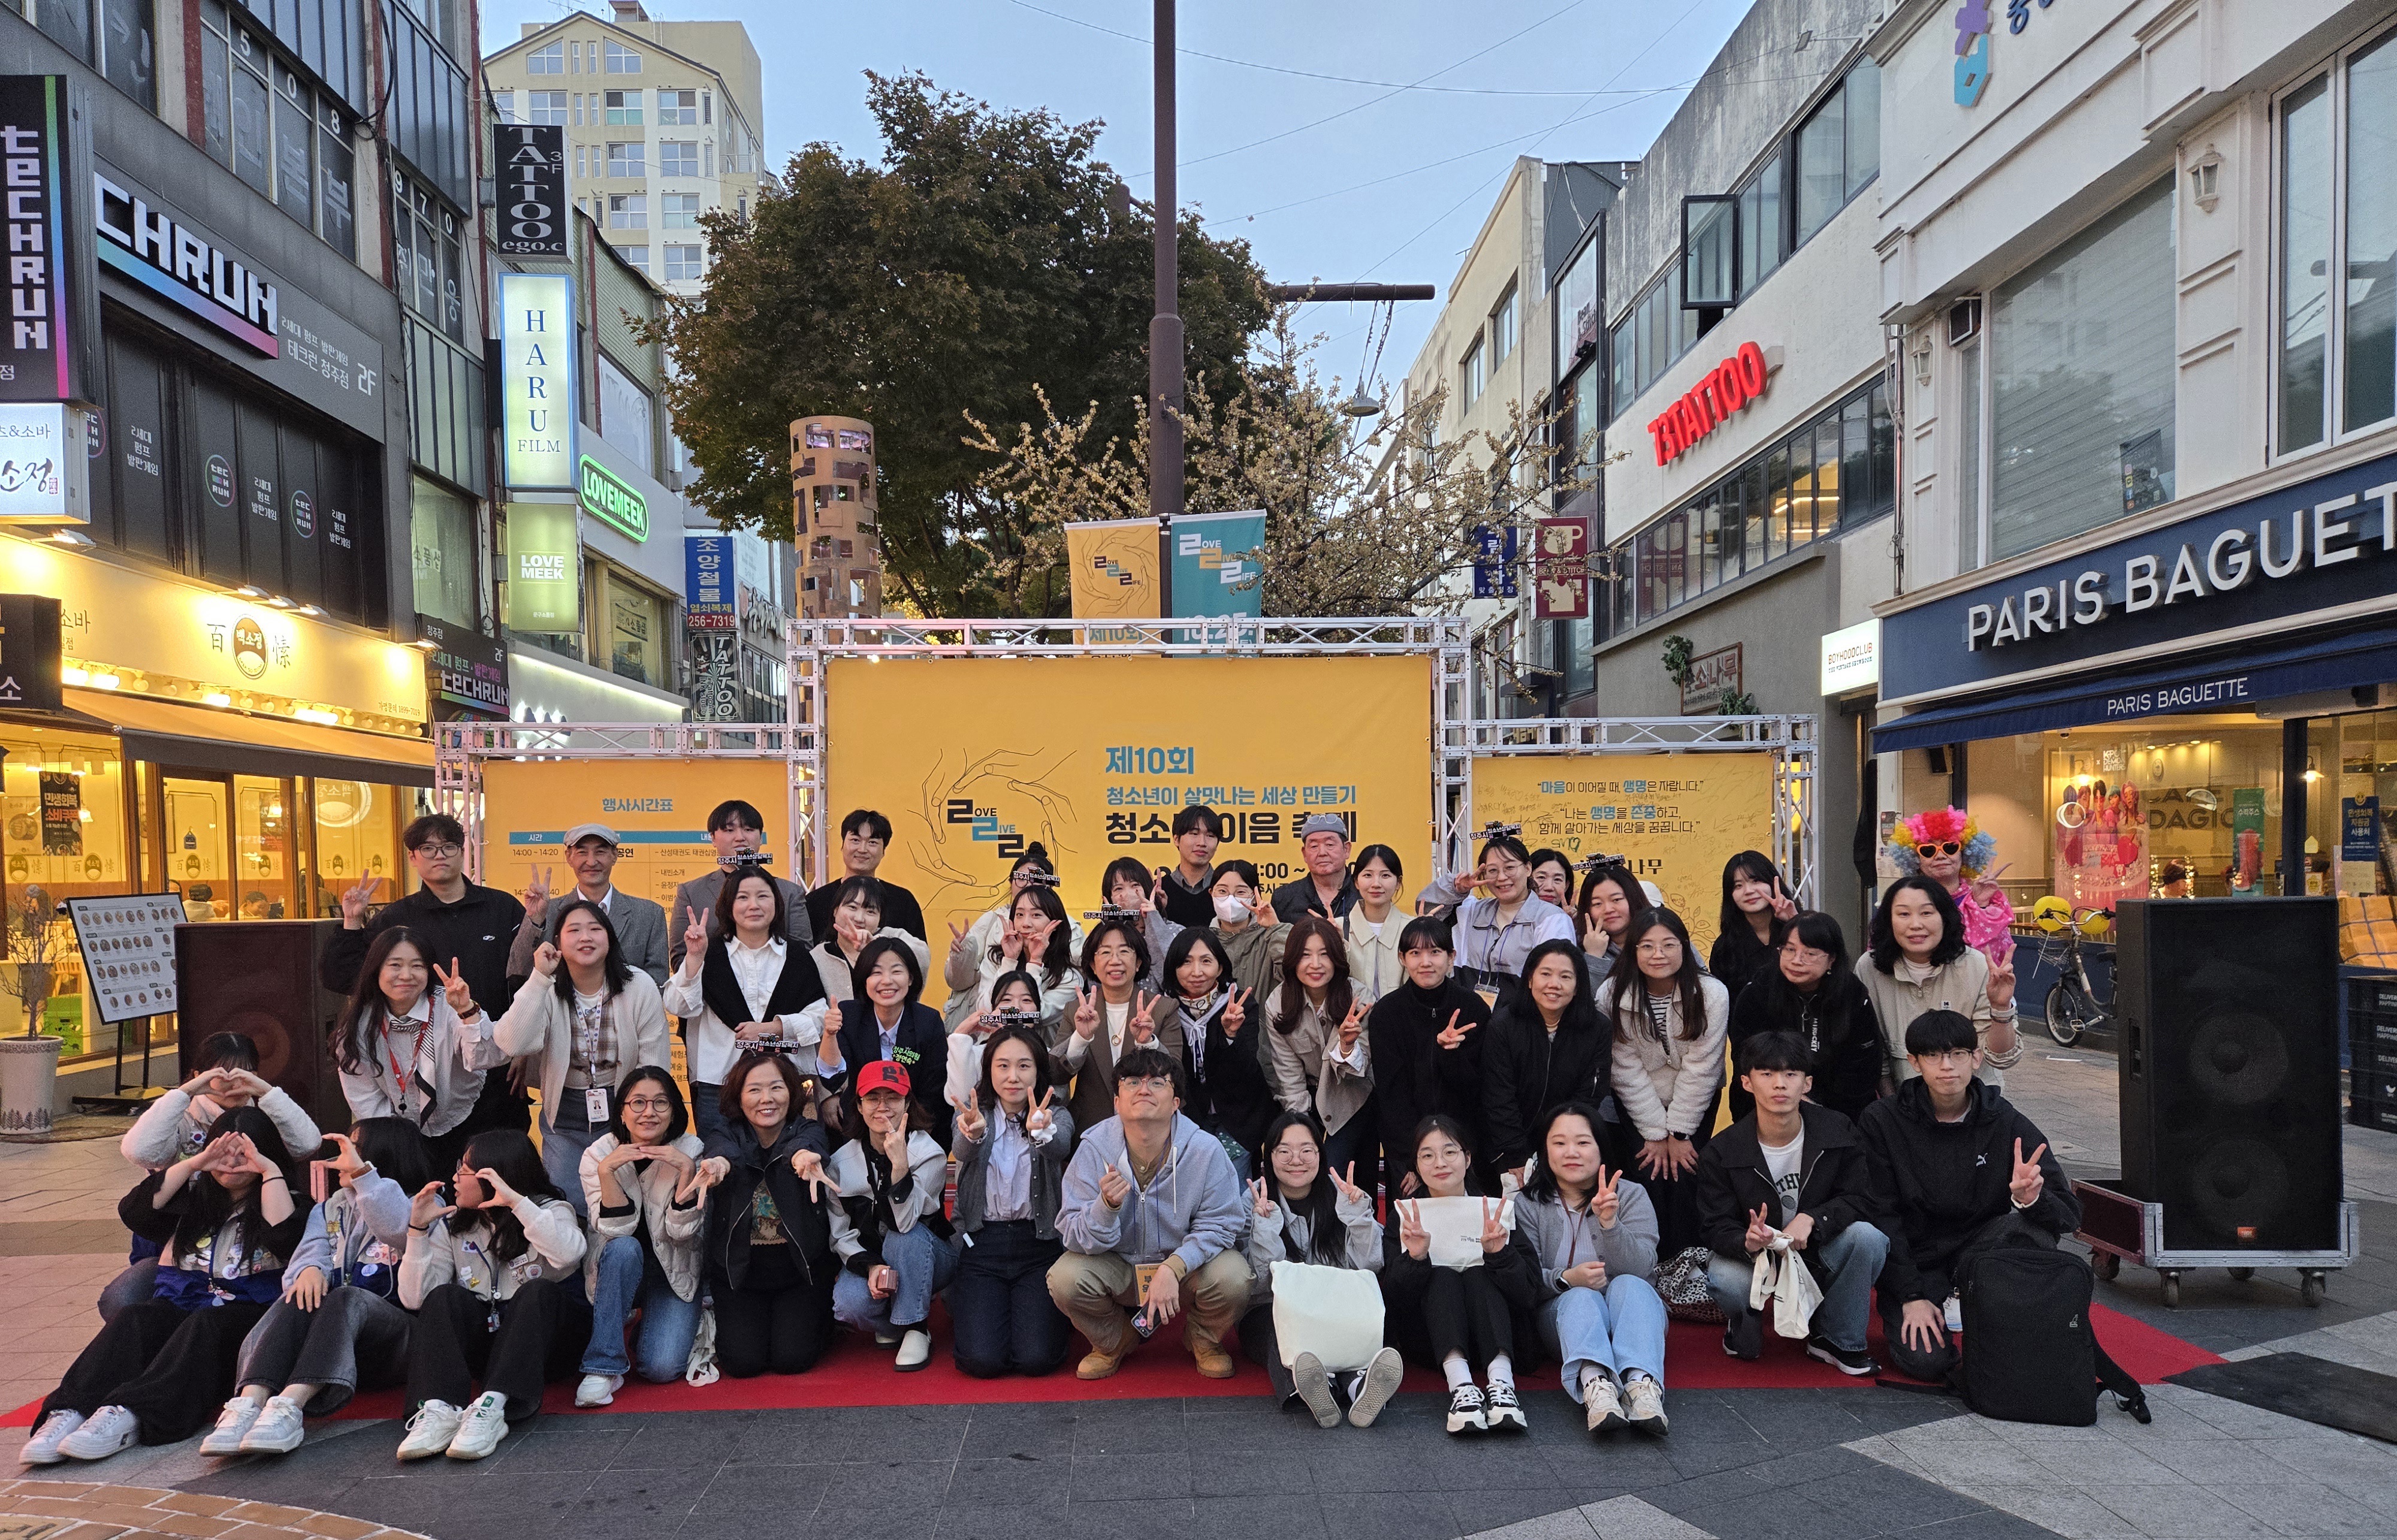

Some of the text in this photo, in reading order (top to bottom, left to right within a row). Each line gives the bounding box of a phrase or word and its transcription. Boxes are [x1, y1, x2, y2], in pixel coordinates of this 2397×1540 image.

[508, 127, 553, 239] TATTOO
[321, 340, 348, 366] 발판게임
[288, 339, 349, 389] 테크런 청주점
[524, 309, 548, 432] HARU
[358, 363, 377, 396] 2F
[131, 425, 152, 444] 2세대
[134, 441, 150, 457] 펌프
[517, 440, 561, 452] FILM
[127, 453, 159, 476] 발판게임
[257, 490, 271, 505] 펌프
[583, 465, 645, 532] LOVEMEEK
[251, 501, 277, 521] 발판게임
[521, 554, 565, 568] LOVE
[521, 568, 565, 580] MEEK
[696, 539, 721, 602] 조양철물
[690, 603, 732, 614] 열쇠복제
[1969, 572, 2109, 652] PARIS
[688, 614, 735, 627] 256-7319
[427, 624, 443, 639] 청주점
[455, 656, 469, 672] 펌프
[1695, 653, 1737, 690] 소나무
[714, 636, 733, 716] TATTOO
[2108, 677, 2248, 716] PARIS BAGUETTE
[1106, 746, 1194, 774] 제10회
[1578, 782, 1607, 793] 이어질
[1609, 782, 1621, 794] 때,
[1622, 780, 1657, 793] 생명은
[1106, 785, 1357, 807] 청소년이 살맛나는 세상 만들기
[602, 798, 674, 811] 행사시간표
[1590, 805, 1628, 820] 생명을
[1631, 805, 1681, 820] 존중하고,
[1539, 822, 1562, 835] 함께
[1565, 822, 1609, 835] 살아가는
[1611, 821, 1646, 834] 세상을
[529, 833, 542, 842] 시간
[539, 848, 559, 856] 14:20
[980, 1014, 1001, 1024] 청주시
[735, 1041, 758, 1050] 청주시
[893, 1046, 920, 1061] 청주시의원
